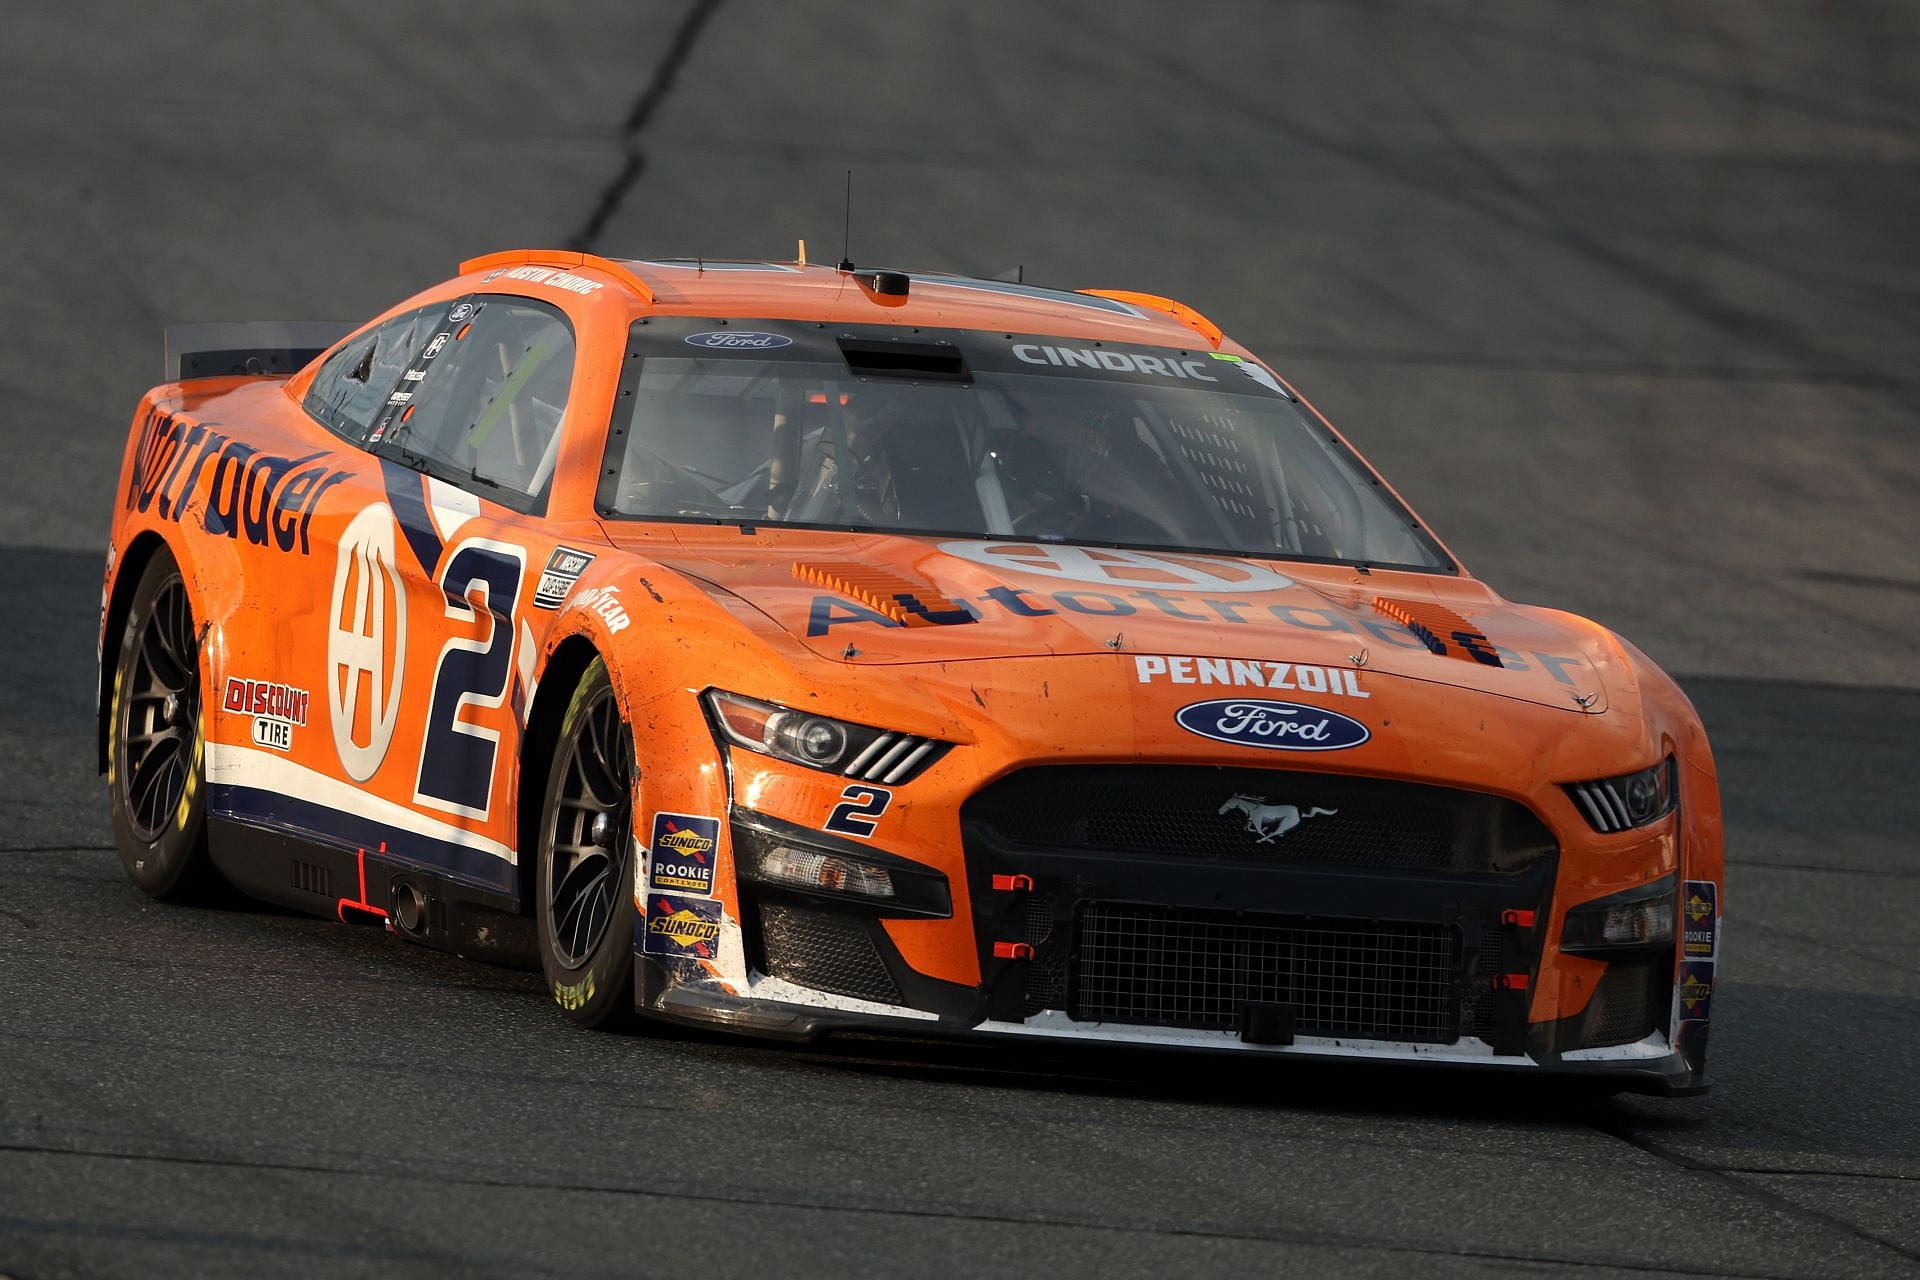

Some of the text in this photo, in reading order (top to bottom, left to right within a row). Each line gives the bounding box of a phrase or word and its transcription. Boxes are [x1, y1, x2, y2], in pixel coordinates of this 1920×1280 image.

[706, 333, 772, 347] Ford
[1011, 344, 1219, 382] CINDRIC
[806, 585, 1582, 687] Autotrader
[412, 536, 527, 822] 2
[1134, 655, 1371, 698] PENNZOIL
[223, 677, 309, 727] DISCOUNT
[258, 720, 290, 746] TIRE
[1216, 704, 1331, 741] Ford
[823, 784, 893, 838] 2
[660, 833, 712, 851] SUNOCO
[655, 862, 711, 880] ROOKIE
[656, 876, 709, 890] CONTENDER
[651, 917, 719, 940] SUNOCO
